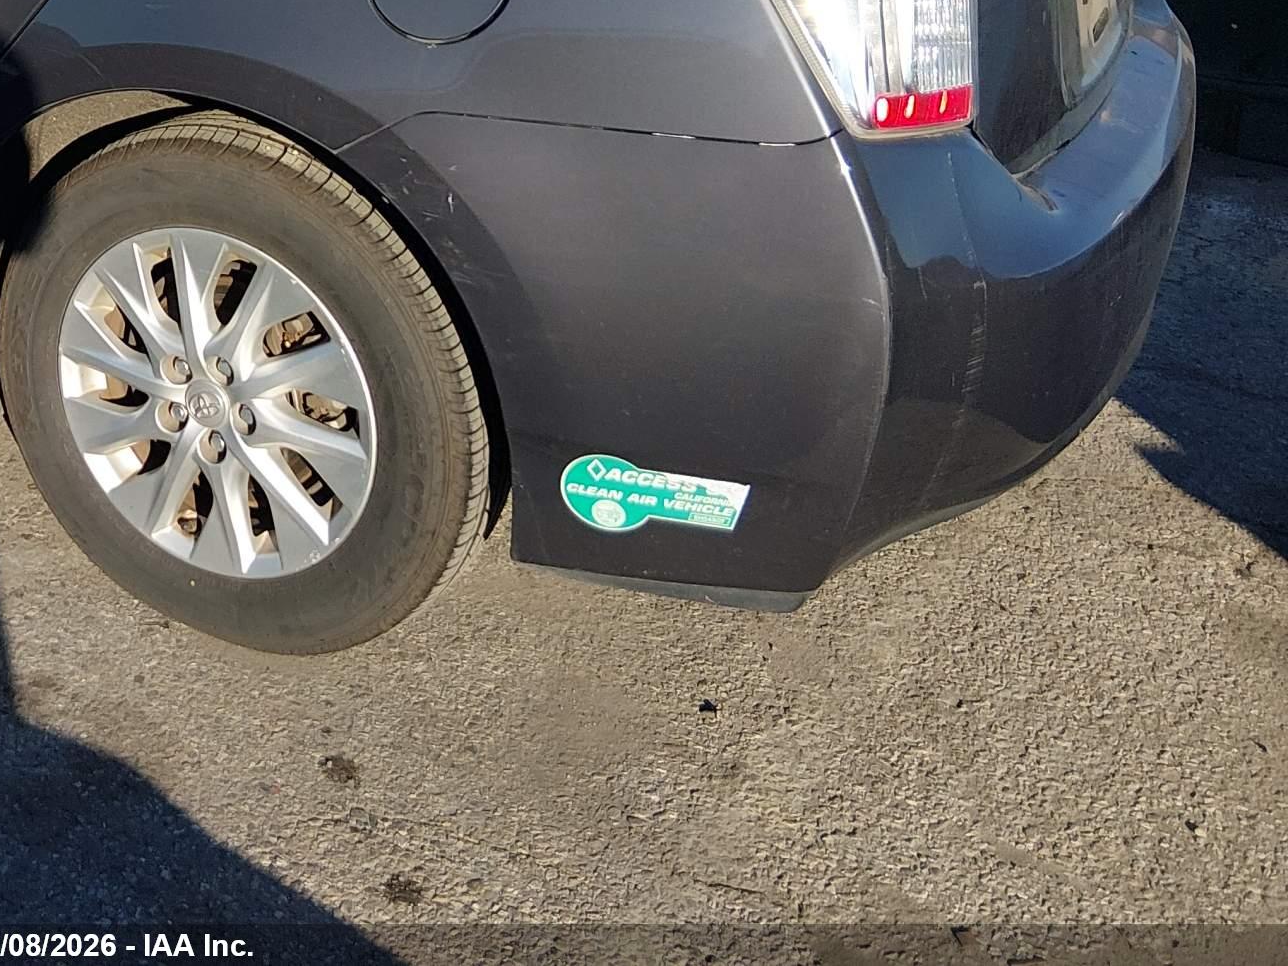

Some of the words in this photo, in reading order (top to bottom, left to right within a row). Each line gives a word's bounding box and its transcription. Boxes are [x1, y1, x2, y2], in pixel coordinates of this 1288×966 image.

[604, 468, 697, 493] ACCESS
[566, 482, 624, 501] CLEAN
[626, 493, 658, 507] AIR
[663, 498, 736, 516] VEHICLE
